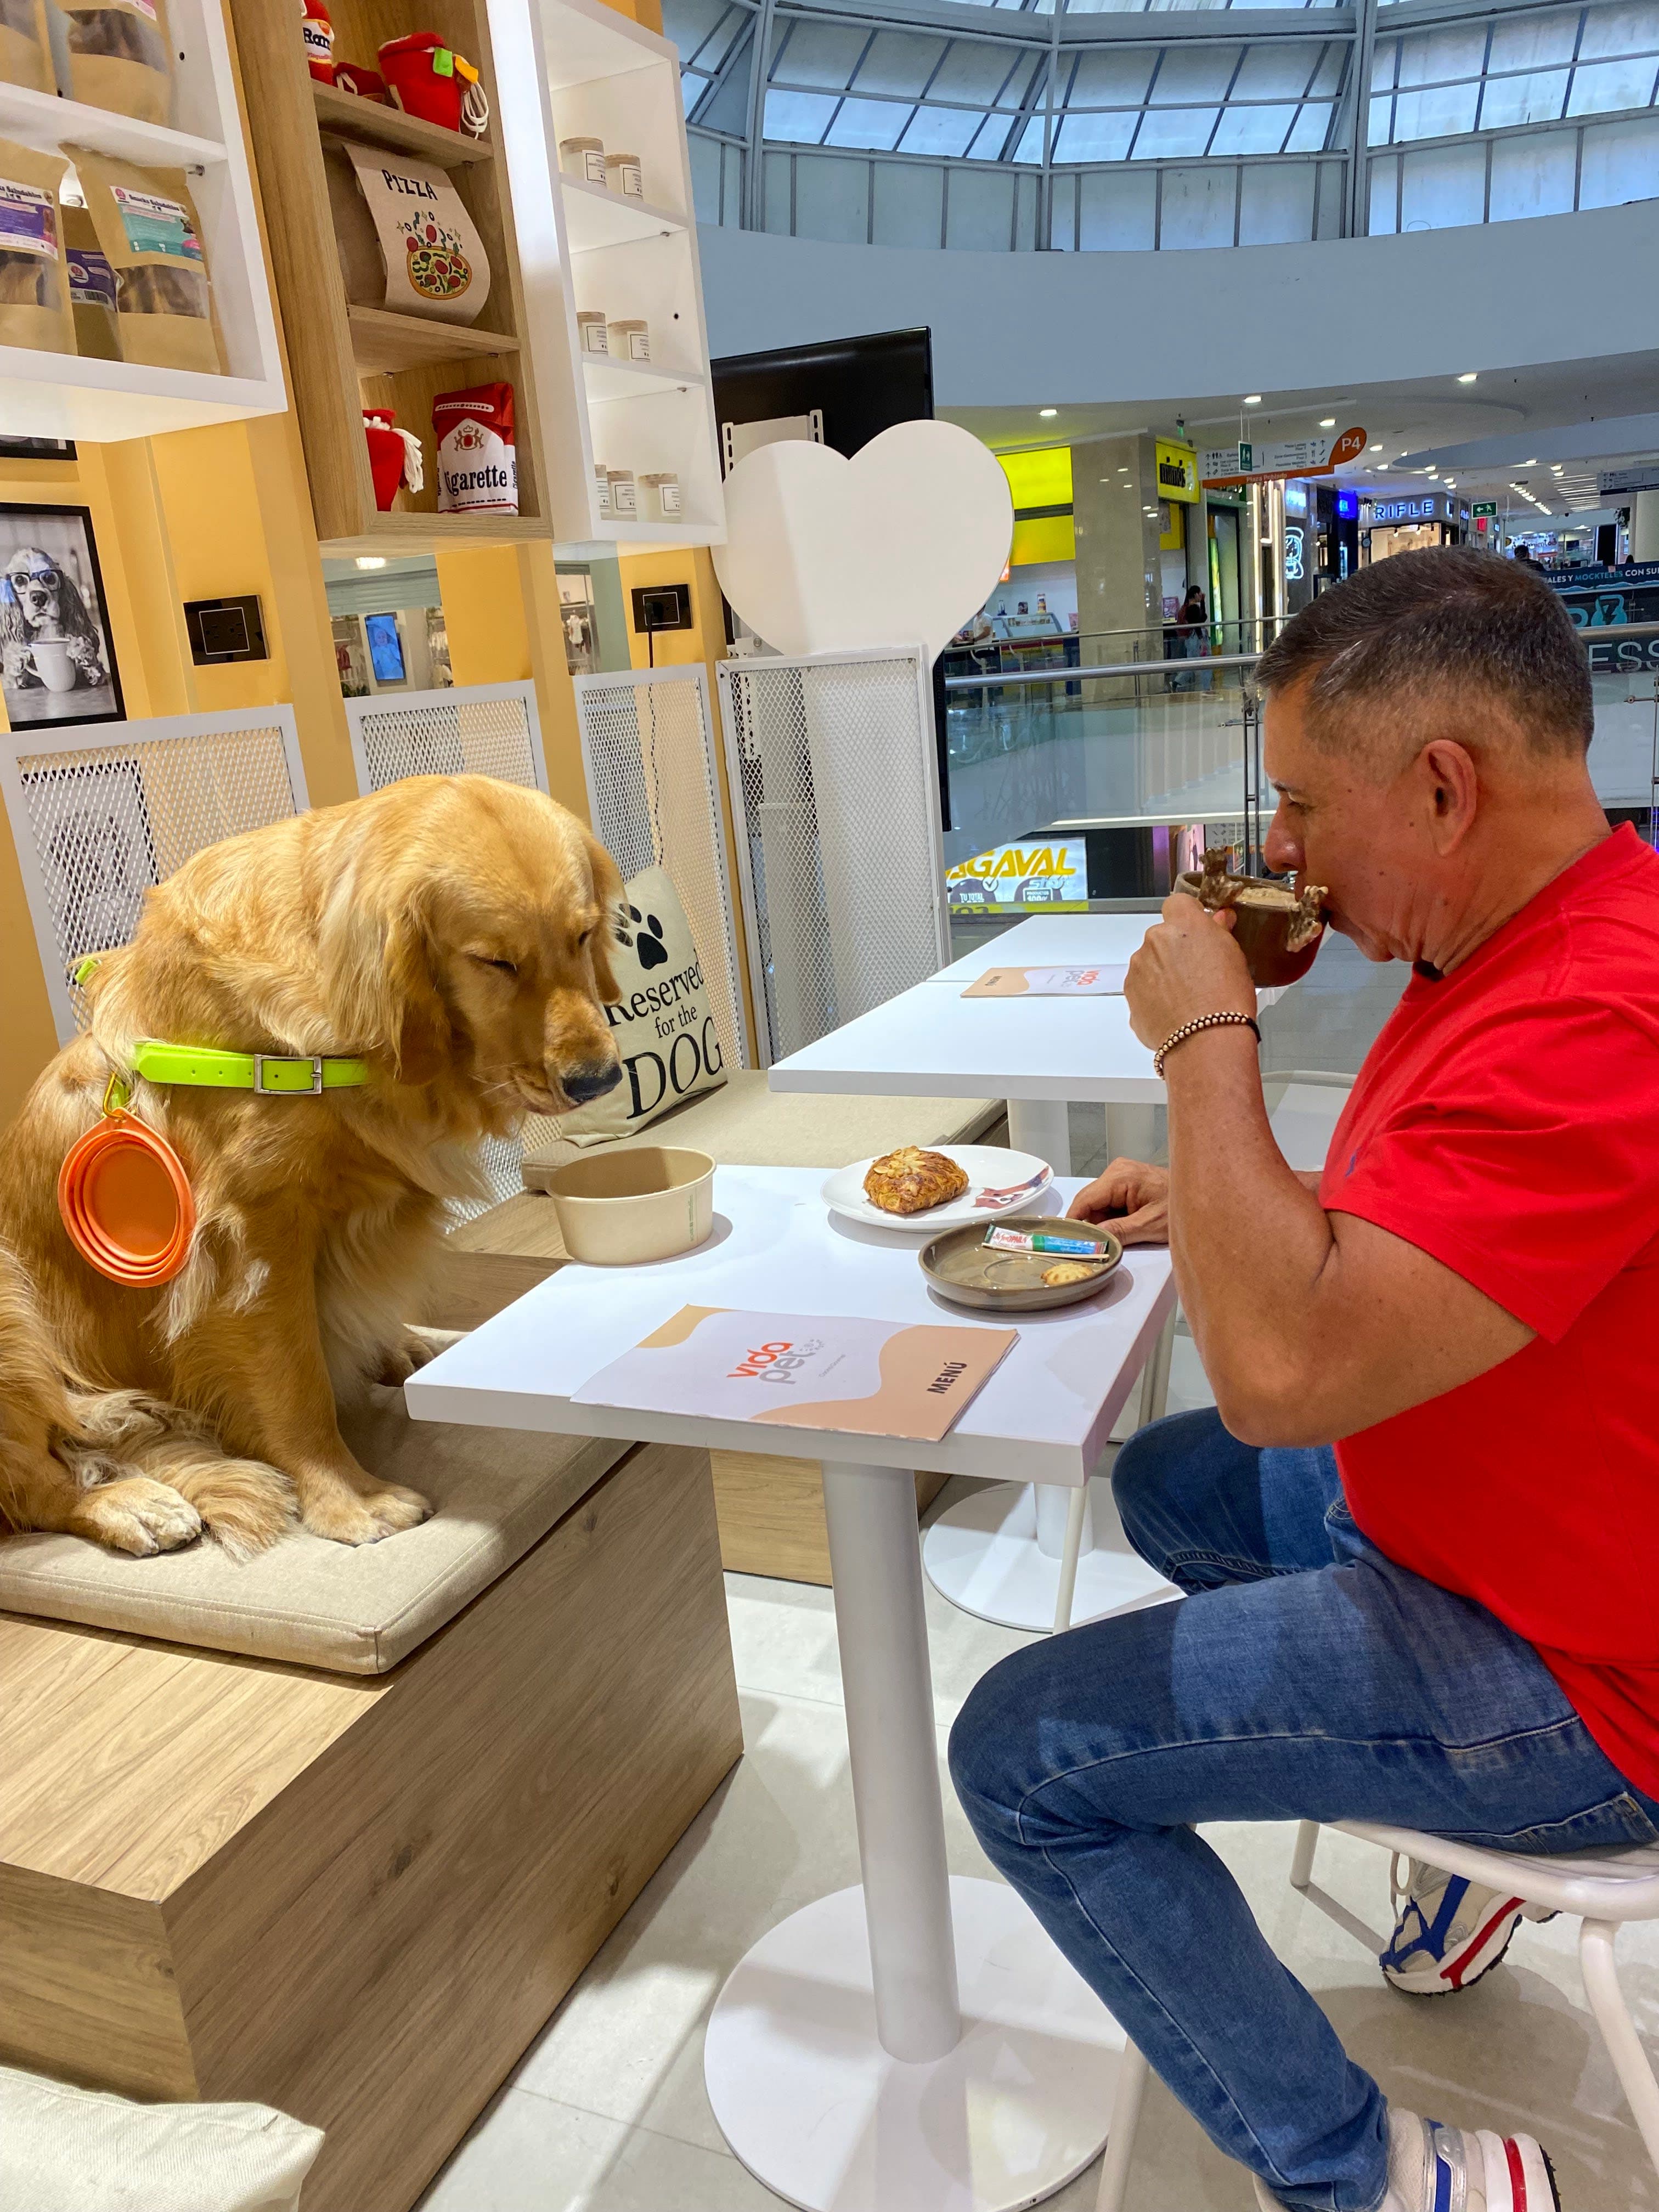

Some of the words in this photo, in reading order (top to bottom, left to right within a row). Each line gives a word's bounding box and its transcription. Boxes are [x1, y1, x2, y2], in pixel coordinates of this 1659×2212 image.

[381, 169, 438, 201] PIZZA
[1341, 436, 1361, 452] P4
[1375, 501, 1434, 519] RIFLE
[1575, 571, 1623, 582] MOCKTELES
[1625, 568, 1645, 577] CON
[1645, 566, 1659, 575] SU
[603, 947, 704, 1027] Reserved
[654, 1016, 675, 1039] for
[678, 1004, 698, 1027] the
[622, 1016, 724, 1120] DOG
[725, 1341, 794, 1378] vida
[759, 1350, 817, 1385] pet
[926, 1361, 968, 1394] MENÚ
